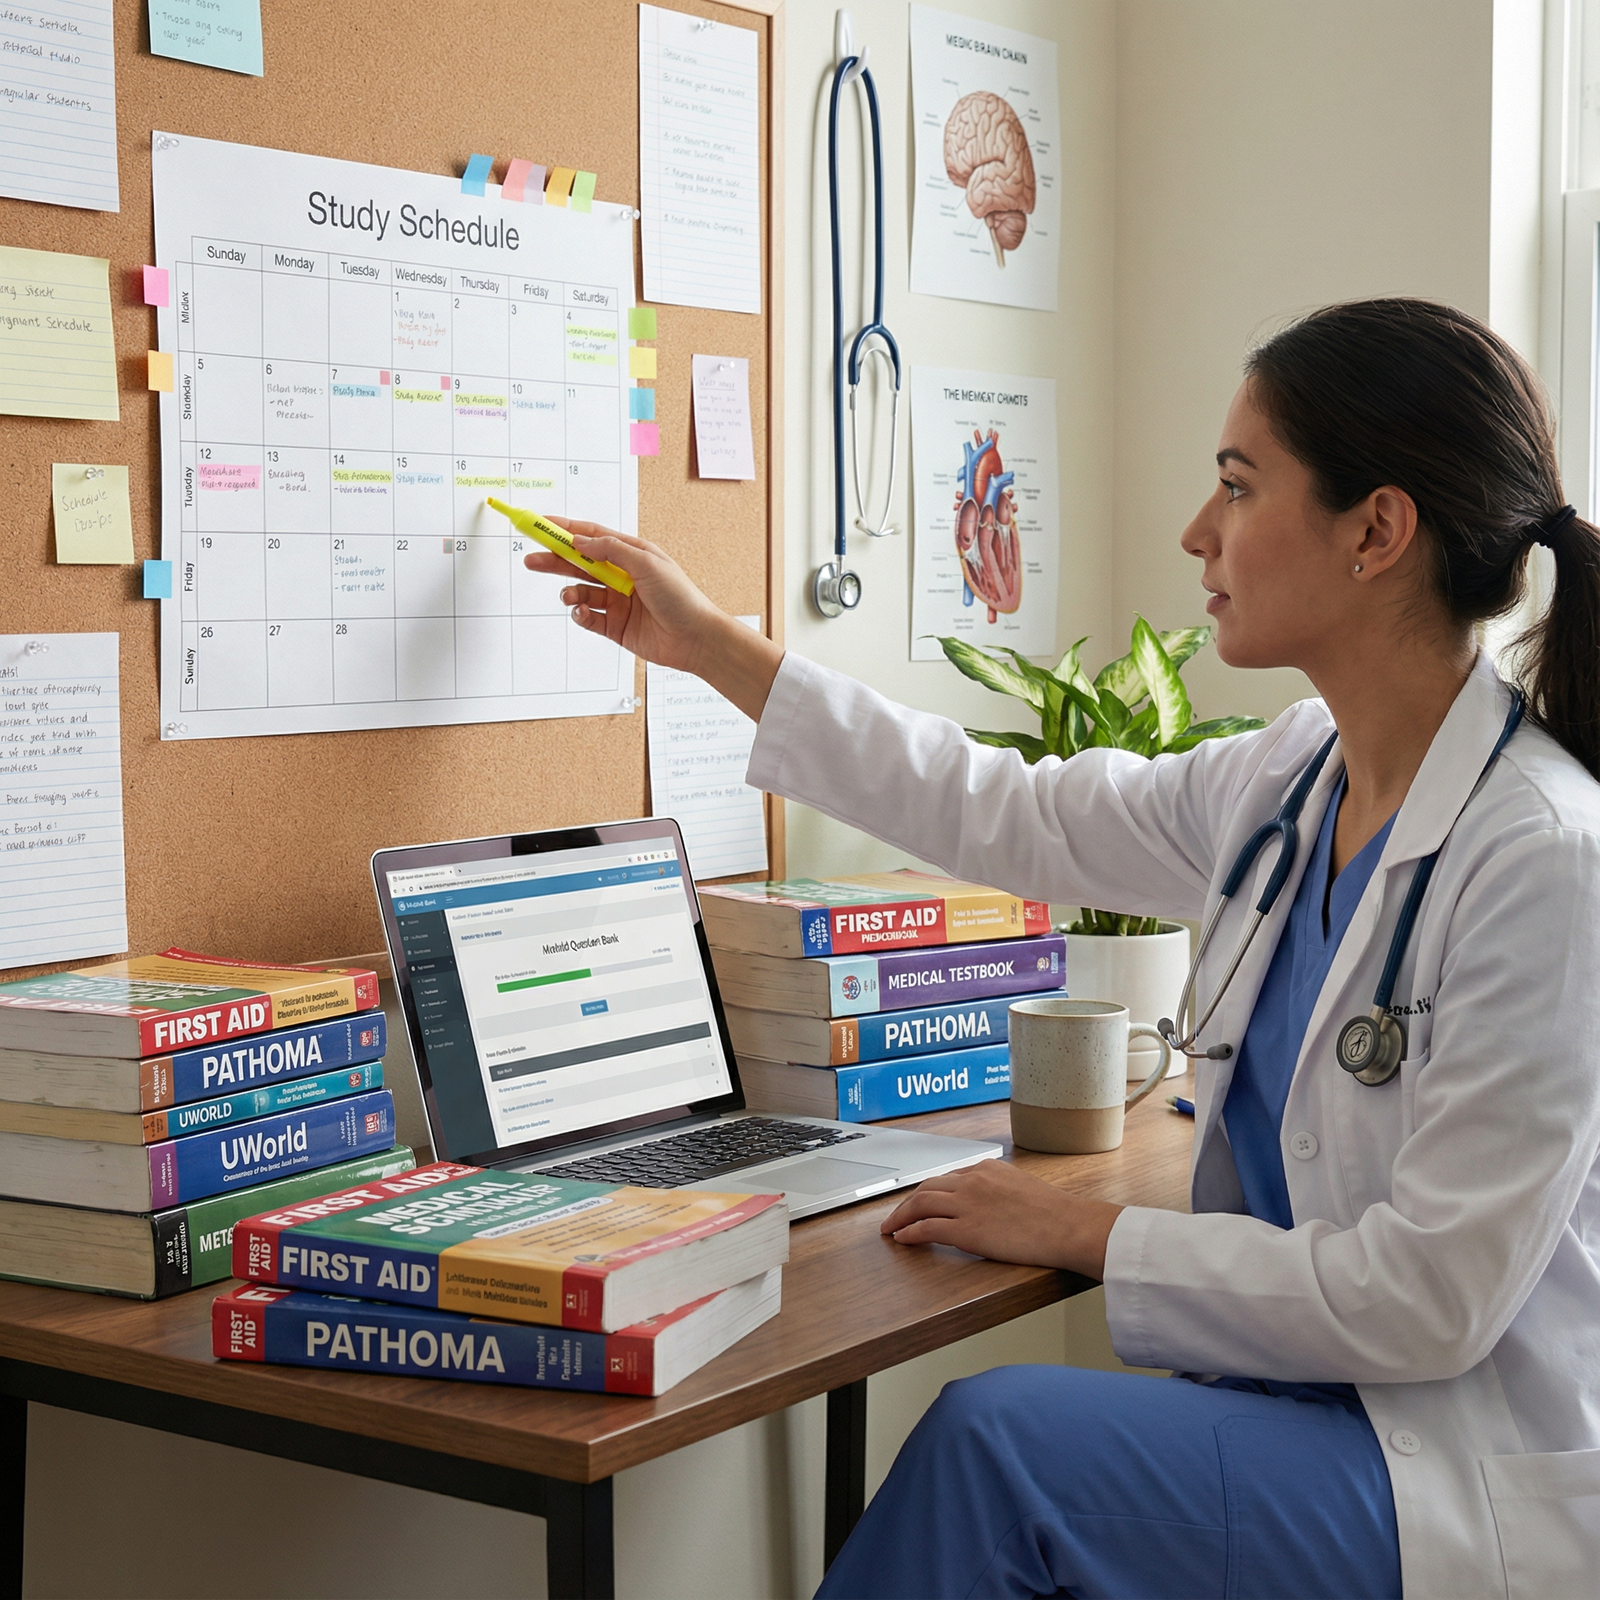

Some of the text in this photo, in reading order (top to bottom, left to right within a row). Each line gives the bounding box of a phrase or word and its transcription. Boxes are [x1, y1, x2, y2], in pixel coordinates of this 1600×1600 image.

[308, 190, 520, 250] Study Schedule
[207, 246, 246, 264] Sunday
[274, 254, 315, 272] Monday
[340, 262, 380, 280] Tuesday
[460, 276, 500, 293] Thursday
[46, 316, 93, 332] Schedule
[395, 292, 572, 320] 1 2 3 4
[198, 359, 576, 398] 5 6 7 8 9 10 11
[944, 388, 960, 400] THE
[200, 448, 578, 475] 12 13 14 15 16 17 18
[201, 538, 523, 551] 19 20 21 22 23 24
[184, 562, 194, 592] Friday
[201, 624, 347, 638] 26 27 28
[836, 910, 896, 933] FIRST
[888, 960, 1014, 990] MEDICAL TESTBOOK
[154, 1010, 221, 1048] FIRST
[885, 1010, 991, 1049] PATHOMA
[202, 1035, 323, 1089] PATHOMA
[897, 1067, 969, 1098] UWorld
[179, 1103, 232, 1128] UWORLD
[221, 1122, 308, 1170] UWorld
[260, 1190, 384, 1226] FIRST
[355, 1181, 525, 1225] MEDICAL
[249, 1234, 260, 1276] FIRST
[282, 1246, 369, 1284] FIRST
[231, 1310, 242, 1353] FIRST
[306, 1321, 505, 1373] PATHOMA
